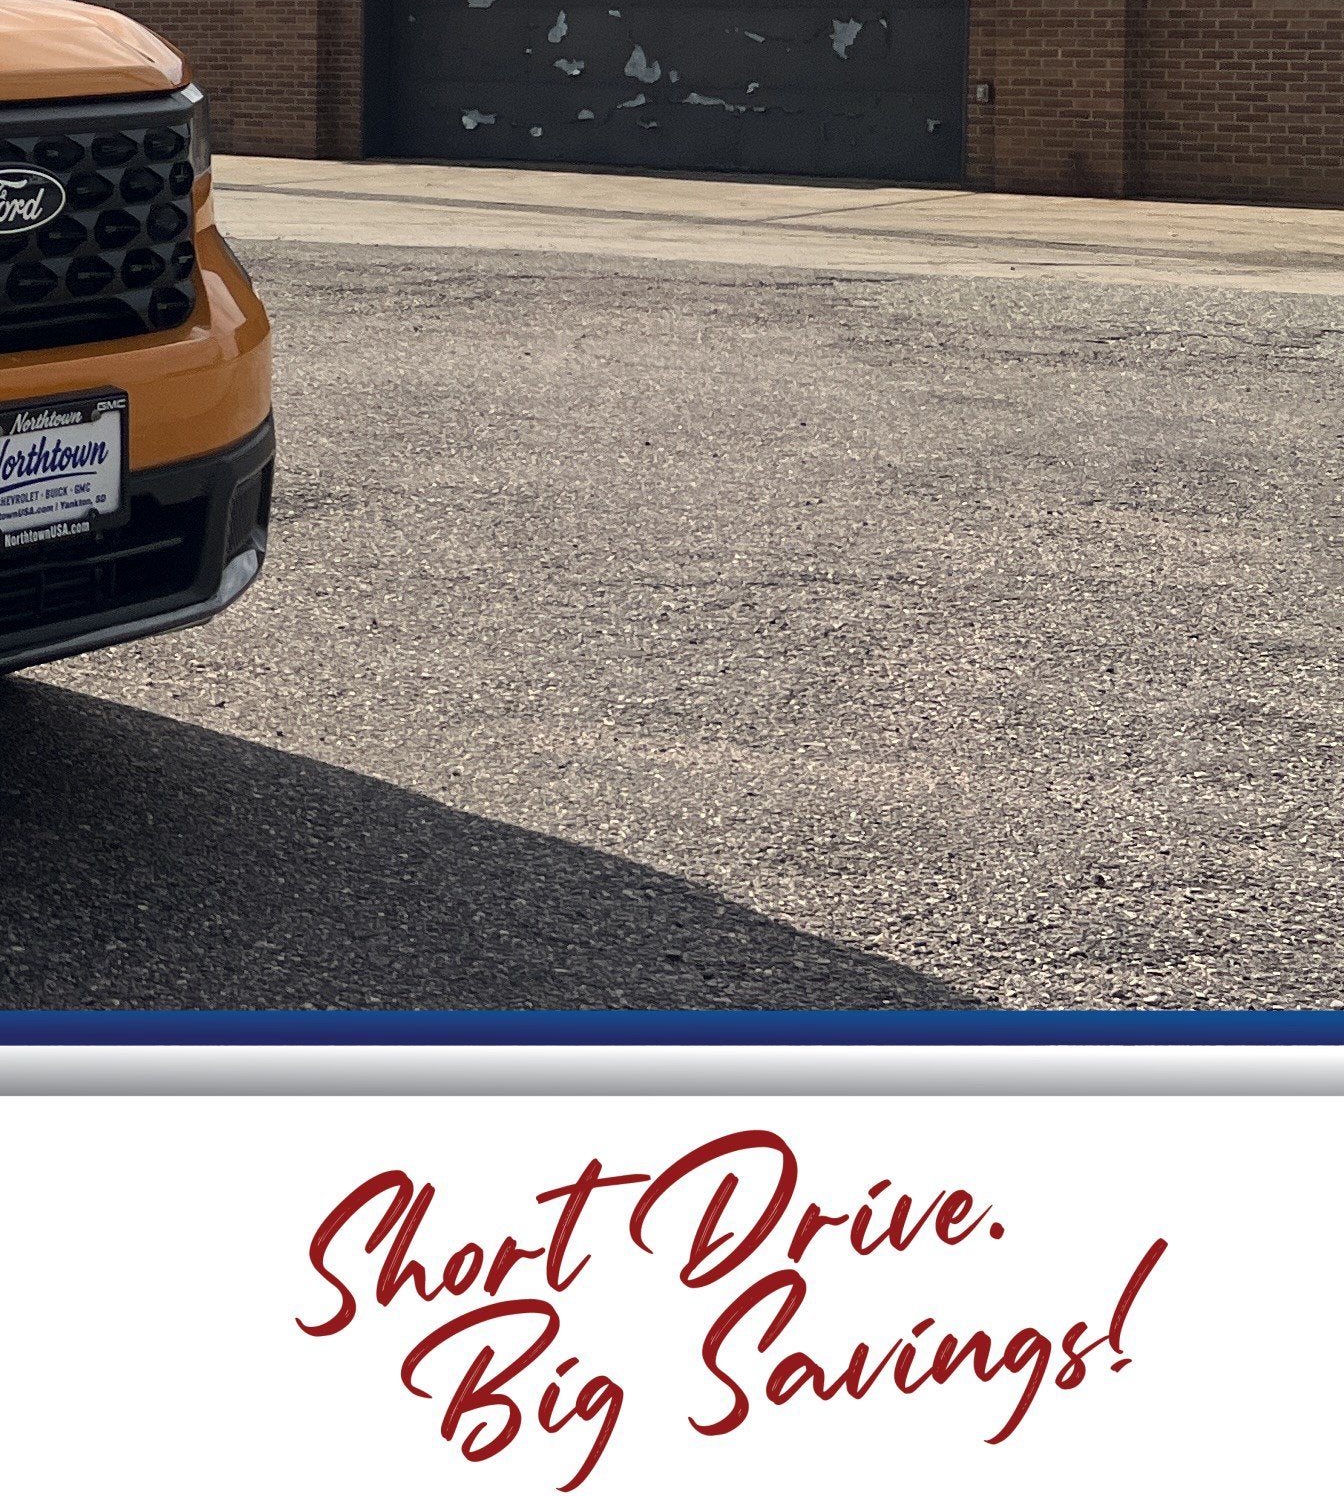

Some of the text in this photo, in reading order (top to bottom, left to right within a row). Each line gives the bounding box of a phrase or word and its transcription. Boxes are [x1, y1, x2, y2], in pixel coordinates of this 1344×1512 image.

[97, 399, 127, 411] GMC
[9, 410, 83, 435] Northtown
[45, 486, 69, 500] BUICK
[74, 482, 91, 495] GMC
[95, 493, 107, 504] SD
[4, 521, 90, 548] NorthtownUSA.com
